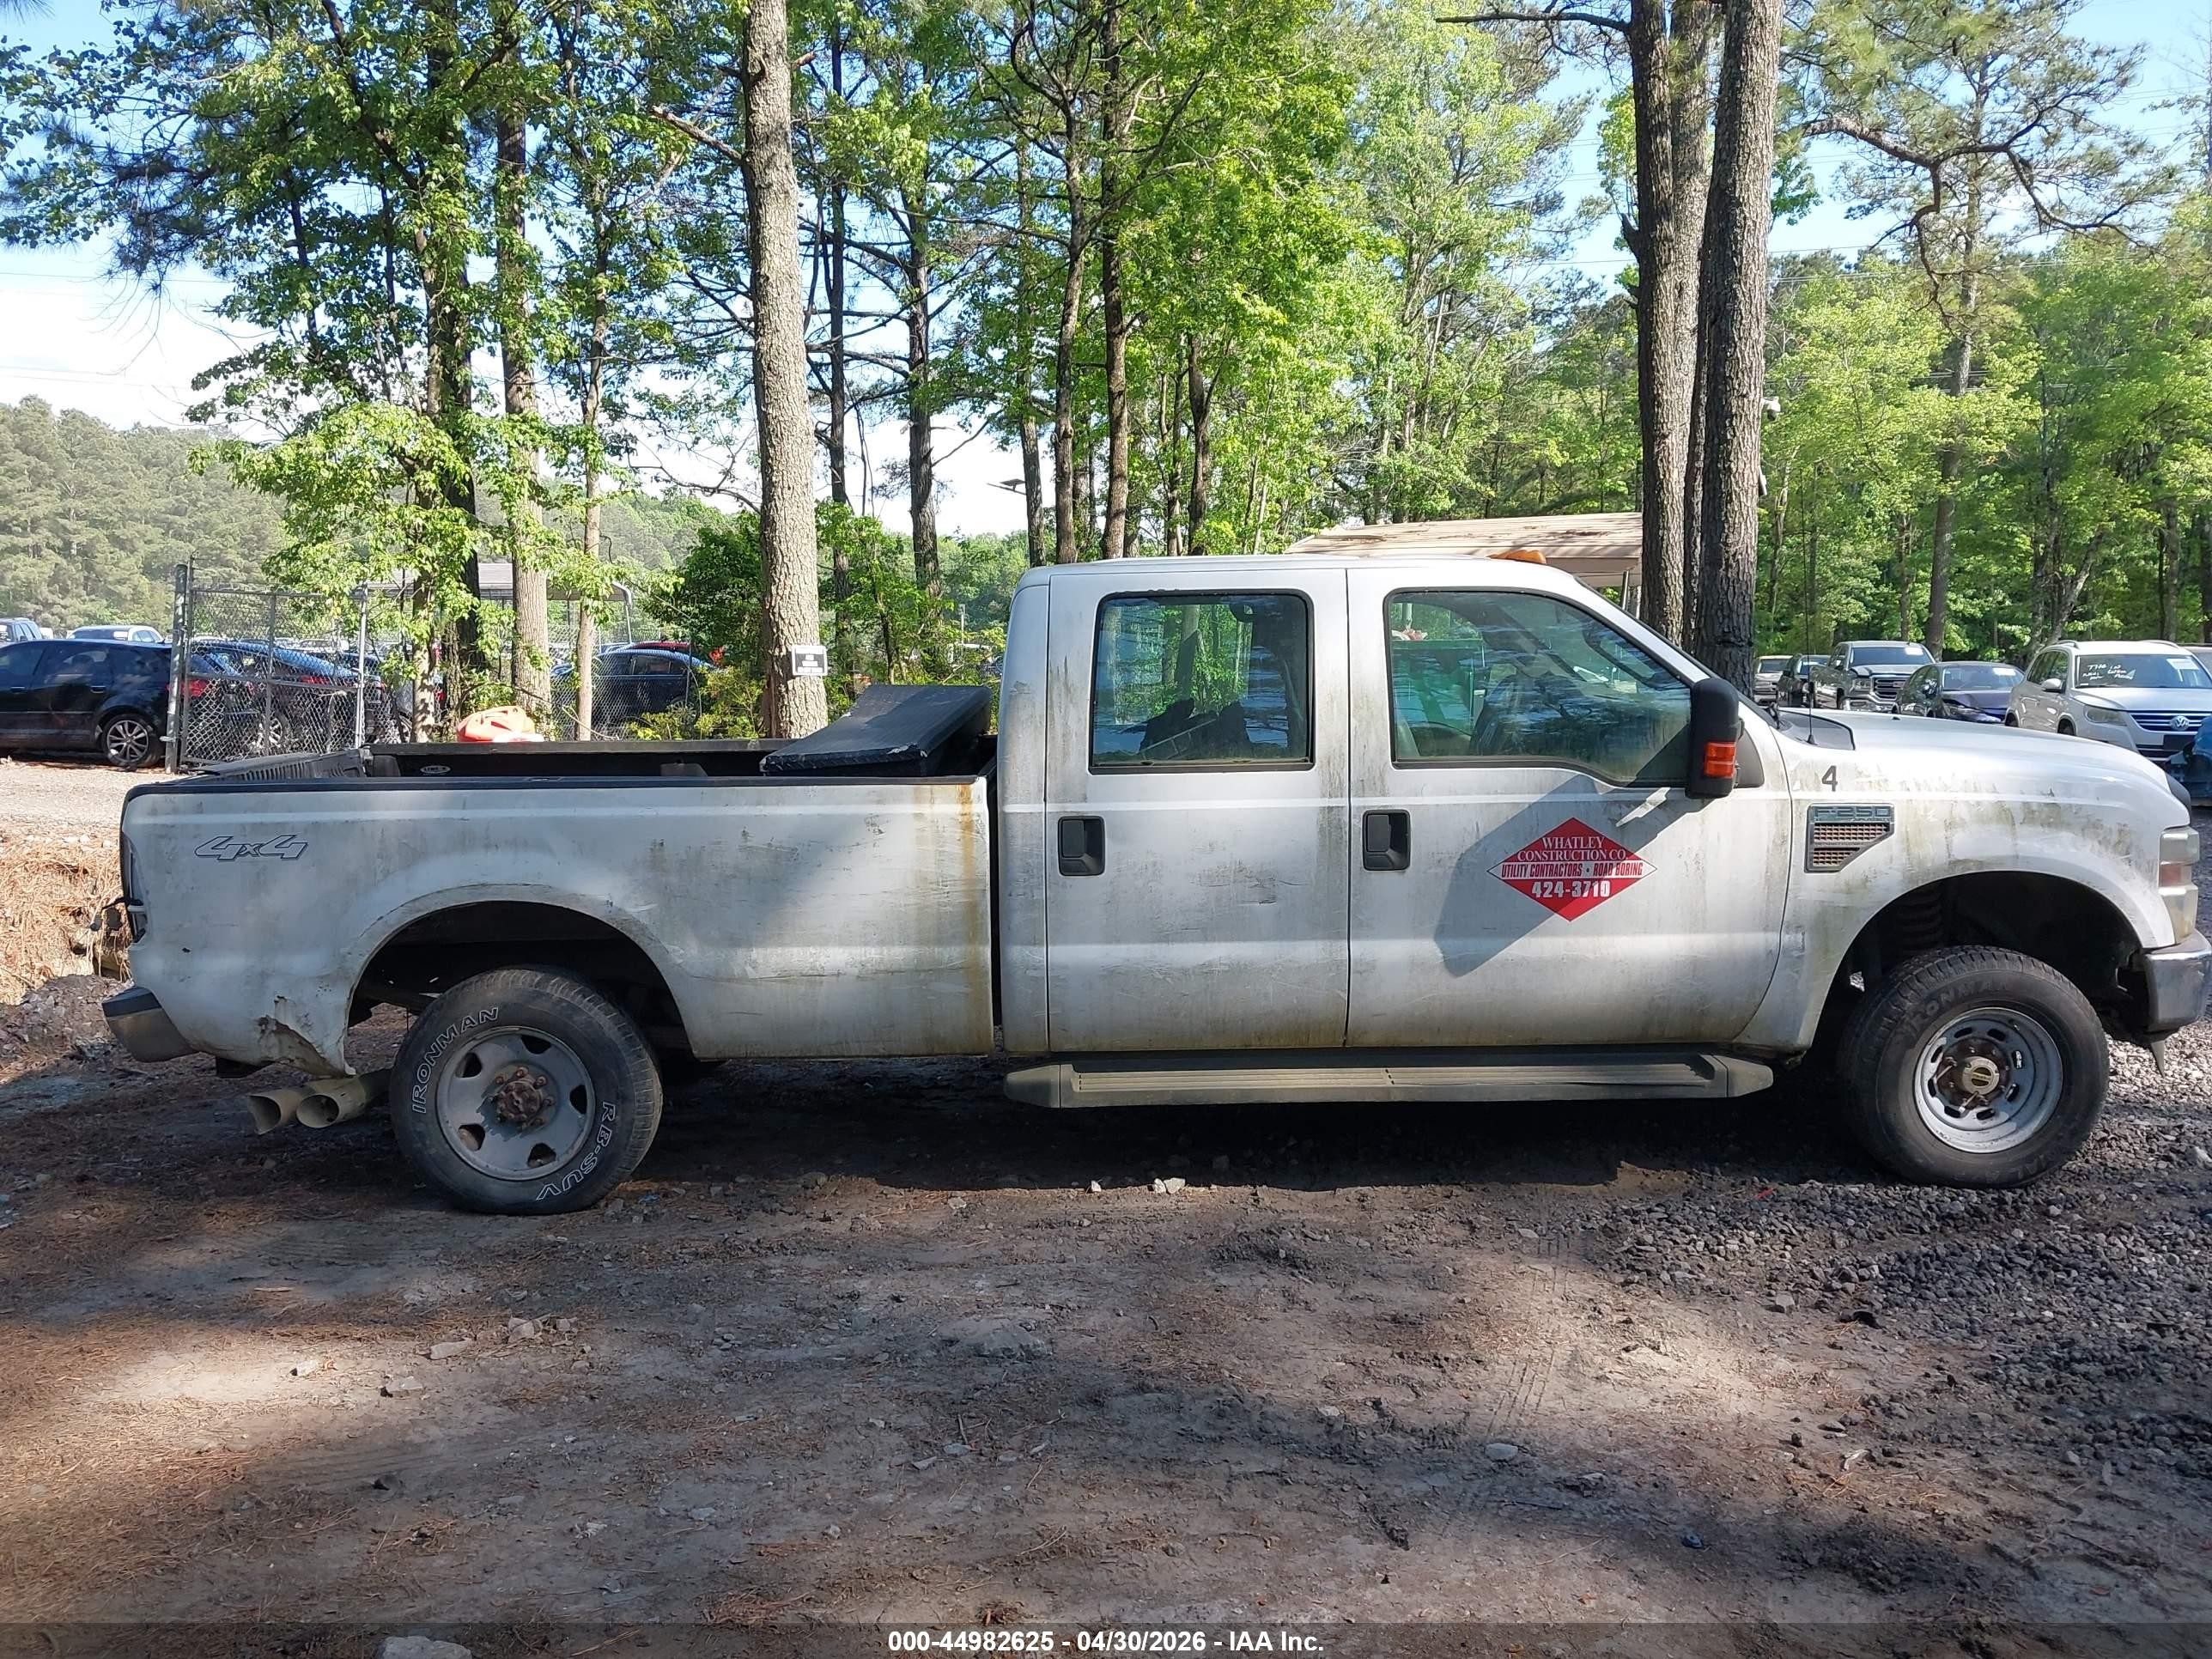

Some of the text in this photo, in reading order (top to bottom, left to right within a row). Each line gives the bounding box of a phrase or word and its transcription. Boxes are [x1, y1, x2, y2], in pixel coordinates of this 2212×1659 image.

[1821, 765, 1838, 792] 4
[1814, 806, 1891, 817] F-250
[194, 834, 309, 861] 4x4
[1542, 836, 1605, 849] WHATLEY
[1517, 848, 1629, 861] CONSTRUCTION CO.
[1501, 862, 1644, 878] UTILITY CONTRACTORS ROAD BORING
[1532, 880, 1611, 898] 424-3710
[412, 1006, 499, 1114] IRONMAN
